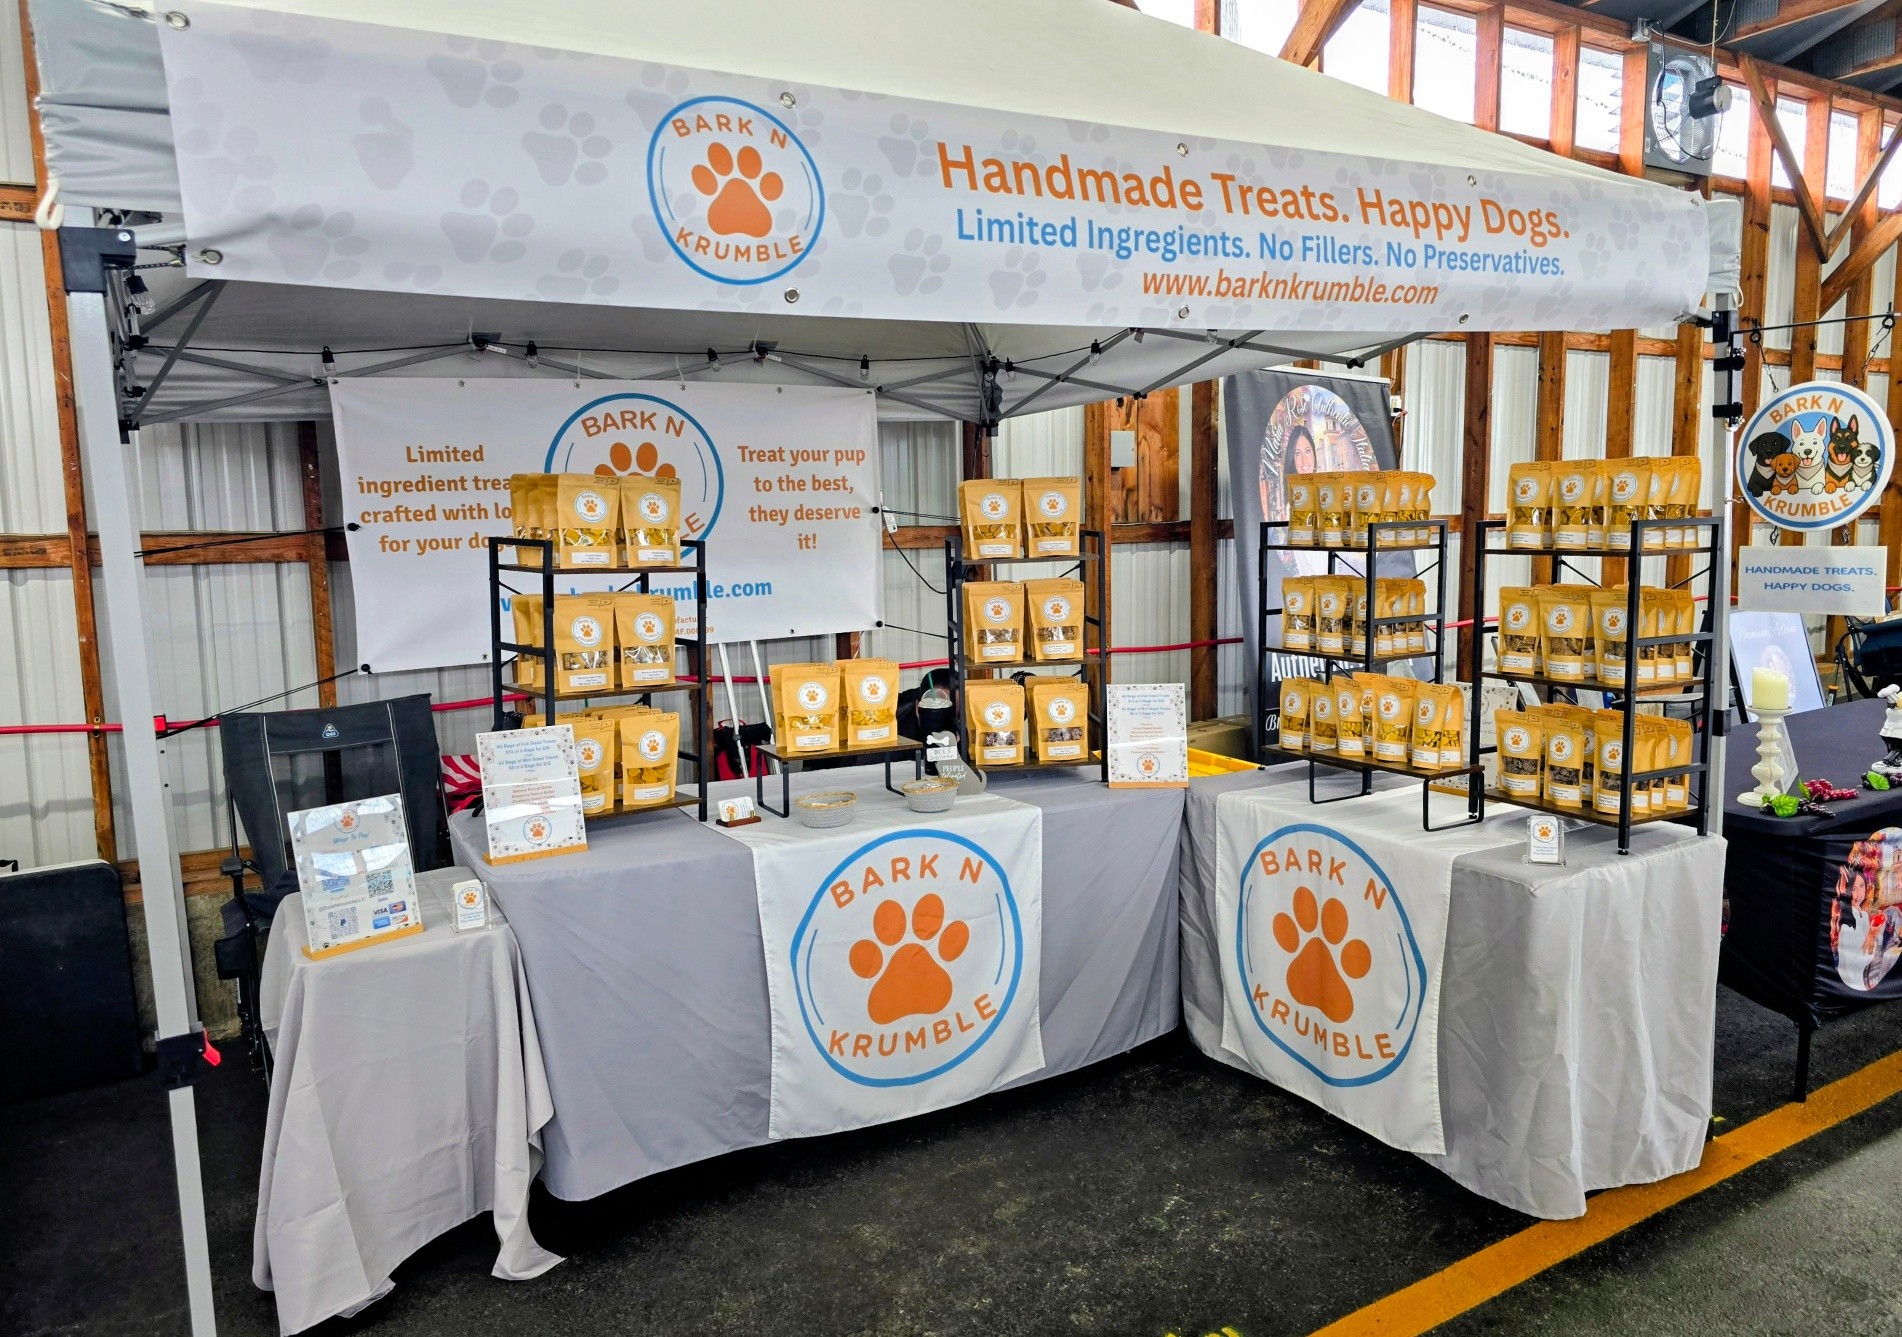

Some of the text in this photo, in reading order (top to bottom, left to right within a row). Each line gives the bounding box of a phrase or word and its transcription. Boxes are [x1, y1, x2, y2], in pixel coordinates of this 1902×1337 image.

[671, 114, 788, 149] BARK N
[937, 142, 1570, 247] Handmade Treats. Happy Dogs.
[676, 227, 804, 262] KRUMBLE
[957, 208, 1565, 276] Limited Ingregients. No Fillers. No Preservatives.
[1143, 268, 1438, 304] www.barknkrumble.com
[1769, 395, 1844, 425] BARK N
[581, 410, 685, 438] BARK N
[1262, 424, 1284, 476] Maria
[1311, 391, 1354, 430] Authentic
[406, 445, 484, 463] Limited
[737, 445, 865, 467] Treat your pup
[358, 475, 511, 498] ingredient trea
[753, 474, 854, 494] to the best,
[360, 502, 513, 524] crafted with lo
[749, 504, 861, 526] they deserve
[1763, 493, 1853, 517] KRUMBLE
[379, 535, 410, 552] for
[416, 536, 462, 556] your
[797, 533, 817, 549] it!
[1745, 566, 1877, 576] HANDMADE TREATS.
[1764, 582, 1855, 592] HAPPY DOGS.
[830, 854, 983, 909] BARK N
[1260, 847, 1387, 911] BARK N
[373, 907, 388, 916] VISA
[828, 993, 998, 1058] KRUMBLE
[1253, 983, 1396, 1060] KRUMBLE
